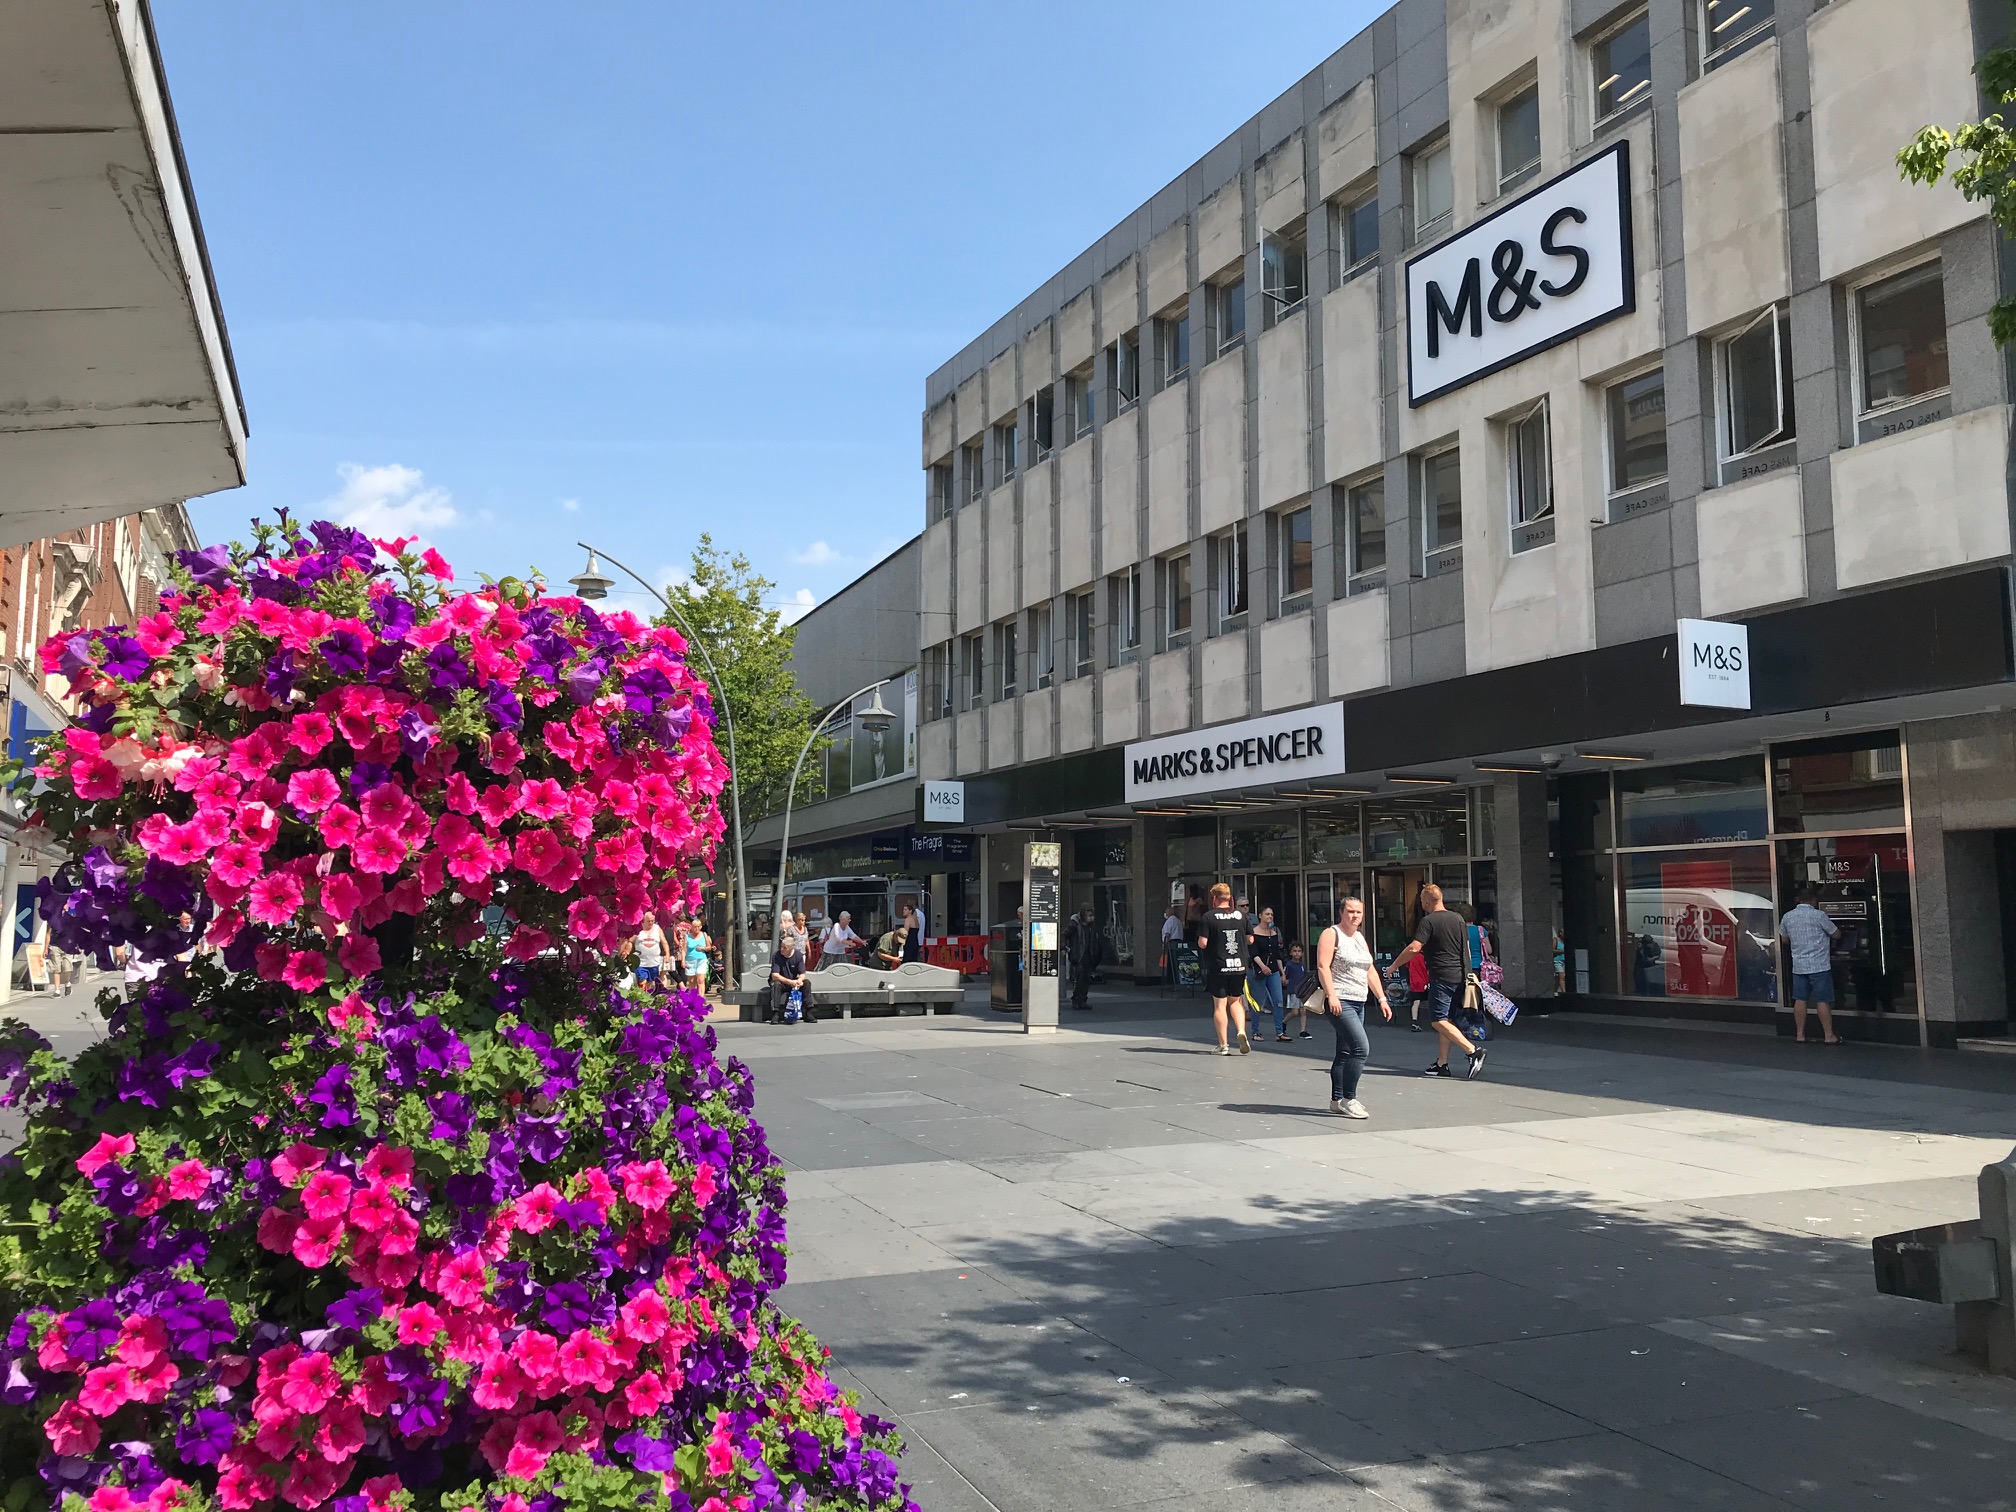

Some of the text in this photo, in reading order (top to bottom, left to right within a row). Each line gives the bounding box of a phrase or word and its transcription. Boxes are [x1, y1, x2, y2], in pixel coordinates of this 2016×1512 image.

[1426, 206, 1589, 358] M&S
[1694, 642, 1742, 671] M&S
[1133, 726, 1324, 785] MARKS & SPENCER
[930, 791, 960, 805] M&S
[911, 837, 923, 851] The
[1828, 861, 1850, 872] M&S
[1669, 924, 1730, 941] 50% OFF
